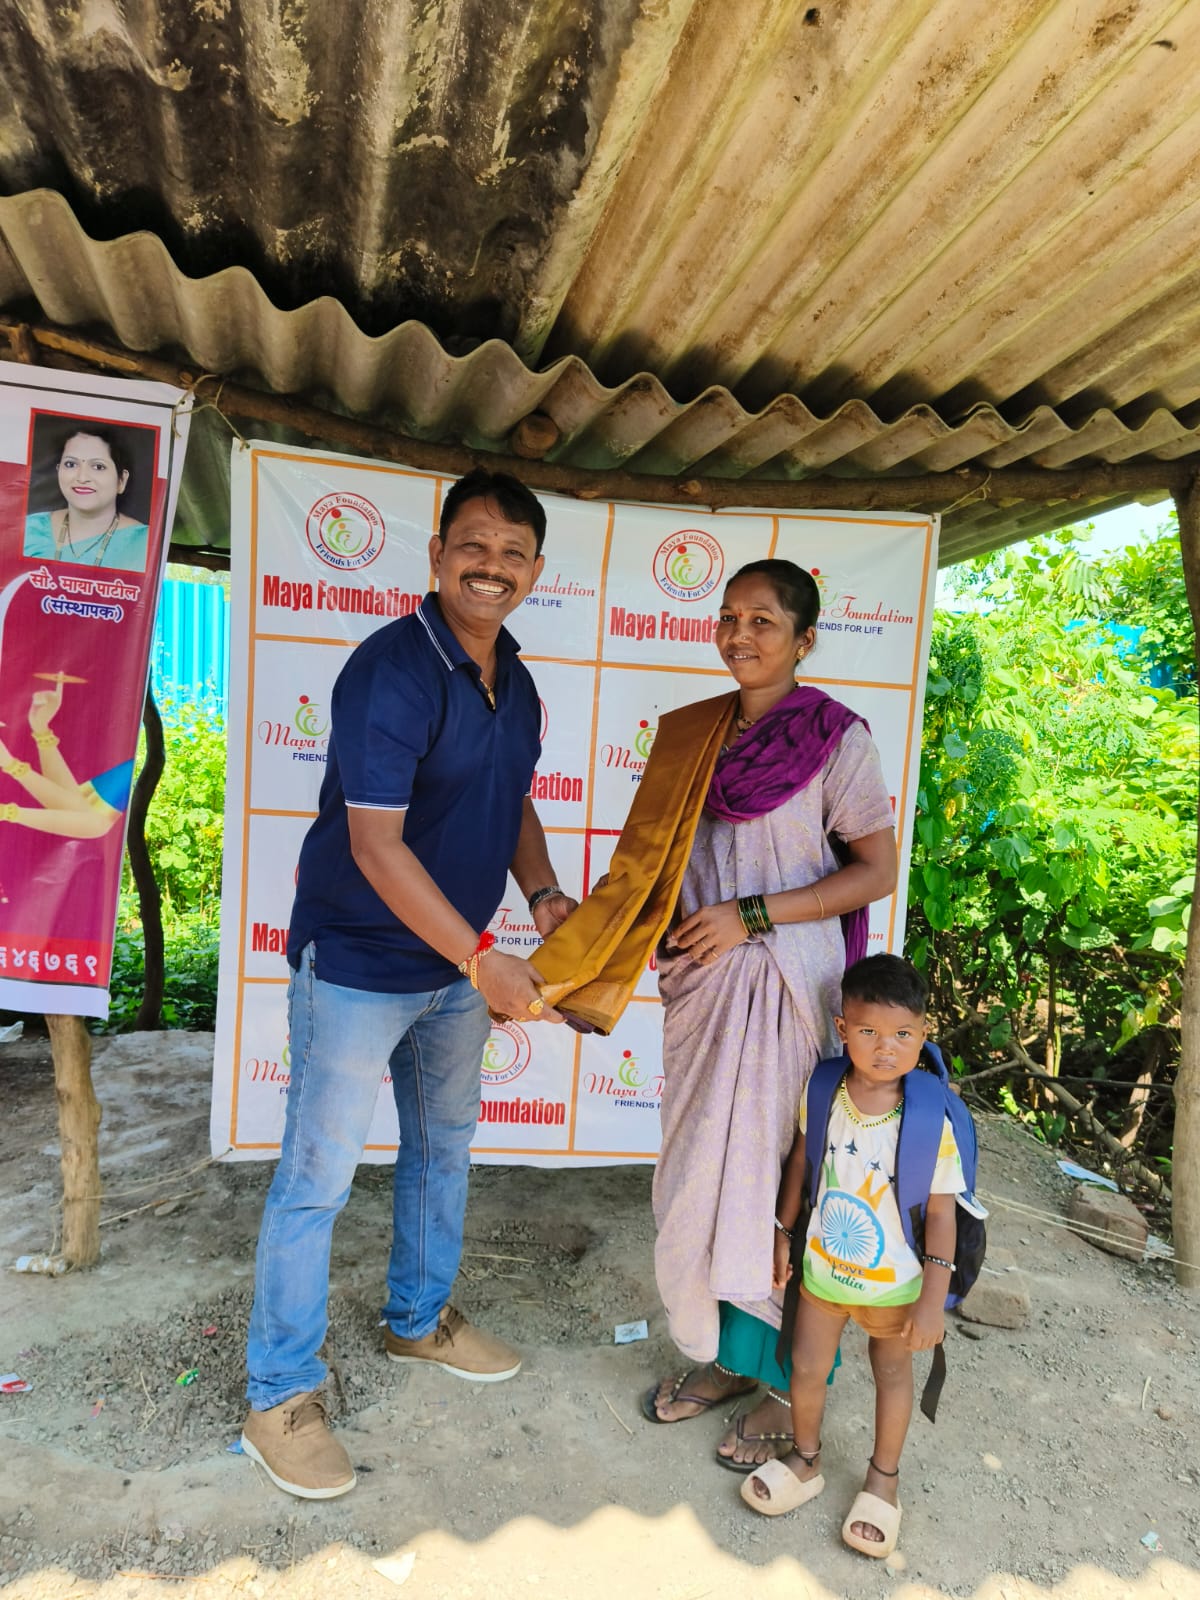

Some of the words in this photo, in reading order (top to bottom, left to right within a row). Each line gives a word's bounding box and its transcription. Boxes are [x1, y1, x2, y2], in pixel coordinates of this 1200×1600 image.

[95, 580, 140, 601] पाटील
[263, 575, 312, 611] Maya
[317, 579, 422, 617] Foundation
[525, 597, 539, 606] OR
[542, 599, 563, 608] LIFE
[41, 594, 124, 622] (संस्थापक)
[831, 595, 913, 624] Foundation
[609, 606, 656, 641] Maya
[816, 621, 842, 631] IENDS
[844, 624, 862, 633] FOR
[864, 626, 884, 635] LIFE
[258, 720, 316, 751] Maya
[601, 744, 646, 773] May
[253, 922, 290, 956] May
[501, 936, 521, 945] FOR
[523, 937, 544, 946] LIFE
[245, 1057, 291, 1085] May
[584, 1072, 637, 1099] Maya
[478, 1097, 565, 1126] oundation
[615, 1100, 655, 1109] FRIENDS
